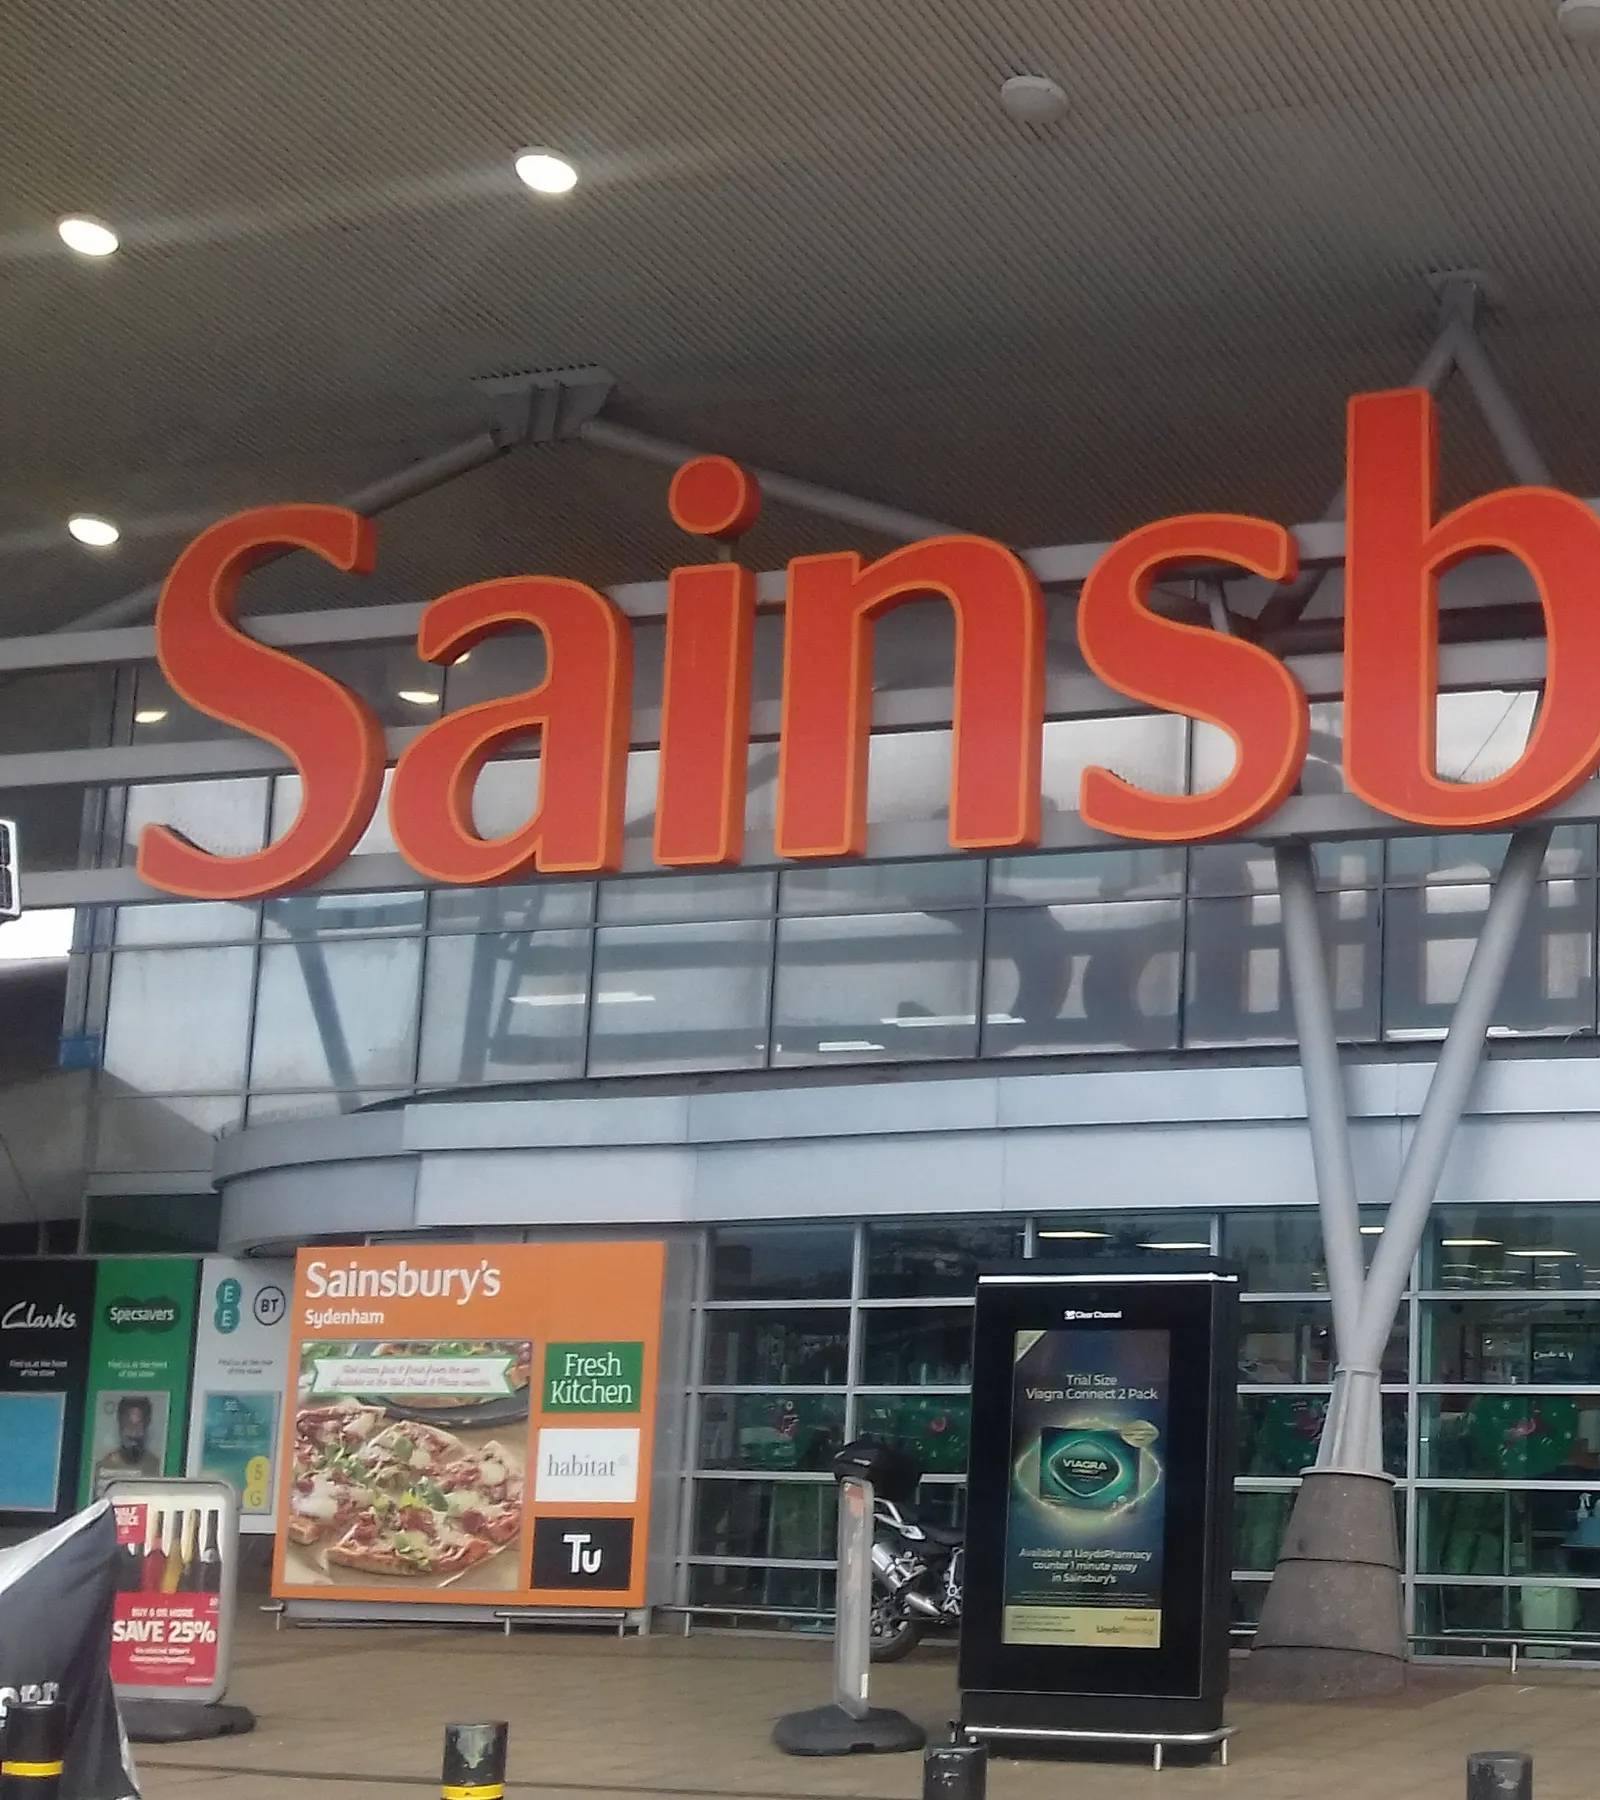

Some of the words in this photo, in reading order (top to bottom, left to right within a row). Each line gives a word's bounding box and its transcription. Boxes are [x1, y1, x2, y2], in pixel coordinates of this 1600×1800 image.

[305, 1258, 501, 1306] Sainsbury's
[1, 1301, 77, 1329] Clarks
[261, 1298, 278, 1312] BT
[110, 1306, 174, 1325] Specsavers
[304, 1308, 385, 1329] Sydenham
[564, 1352, 622, 1377] Fresh
[1066, 1374, 1091, 1385] Trial
[1094, 1374, 1118, 1386] Size
[550, 1378, 633, 1405] Kitchen
[1025, 1388, 1063, 1402] Viagra
[1065, 1388, 1115, 1400] Connect
[1117, 1388, 1126, 1400] 2
[1128, 1388, 1159, 1400] Pack
[547, 1453, 616, 1477] habitat
[1062, 1458, 1108, 1470] VIAGRA
[562, 1533, 603, 1574] Tu
[1019, 1548, 1061, 1558] Available
[1063, 1549, 1073, 1558] at
[1032, 1561, 1070, 1570] counter
[1076, 1561, 1111, 1571] minute
[1112, 1563, 1138, 1574] away
[1051, 1572, 1062, 1582] in
[1063, 1572, 1117, 1585] Sainsbury's
[112, 1620, 165, 1642] SAVE
[167, 1621, 217, 1643] 25%
